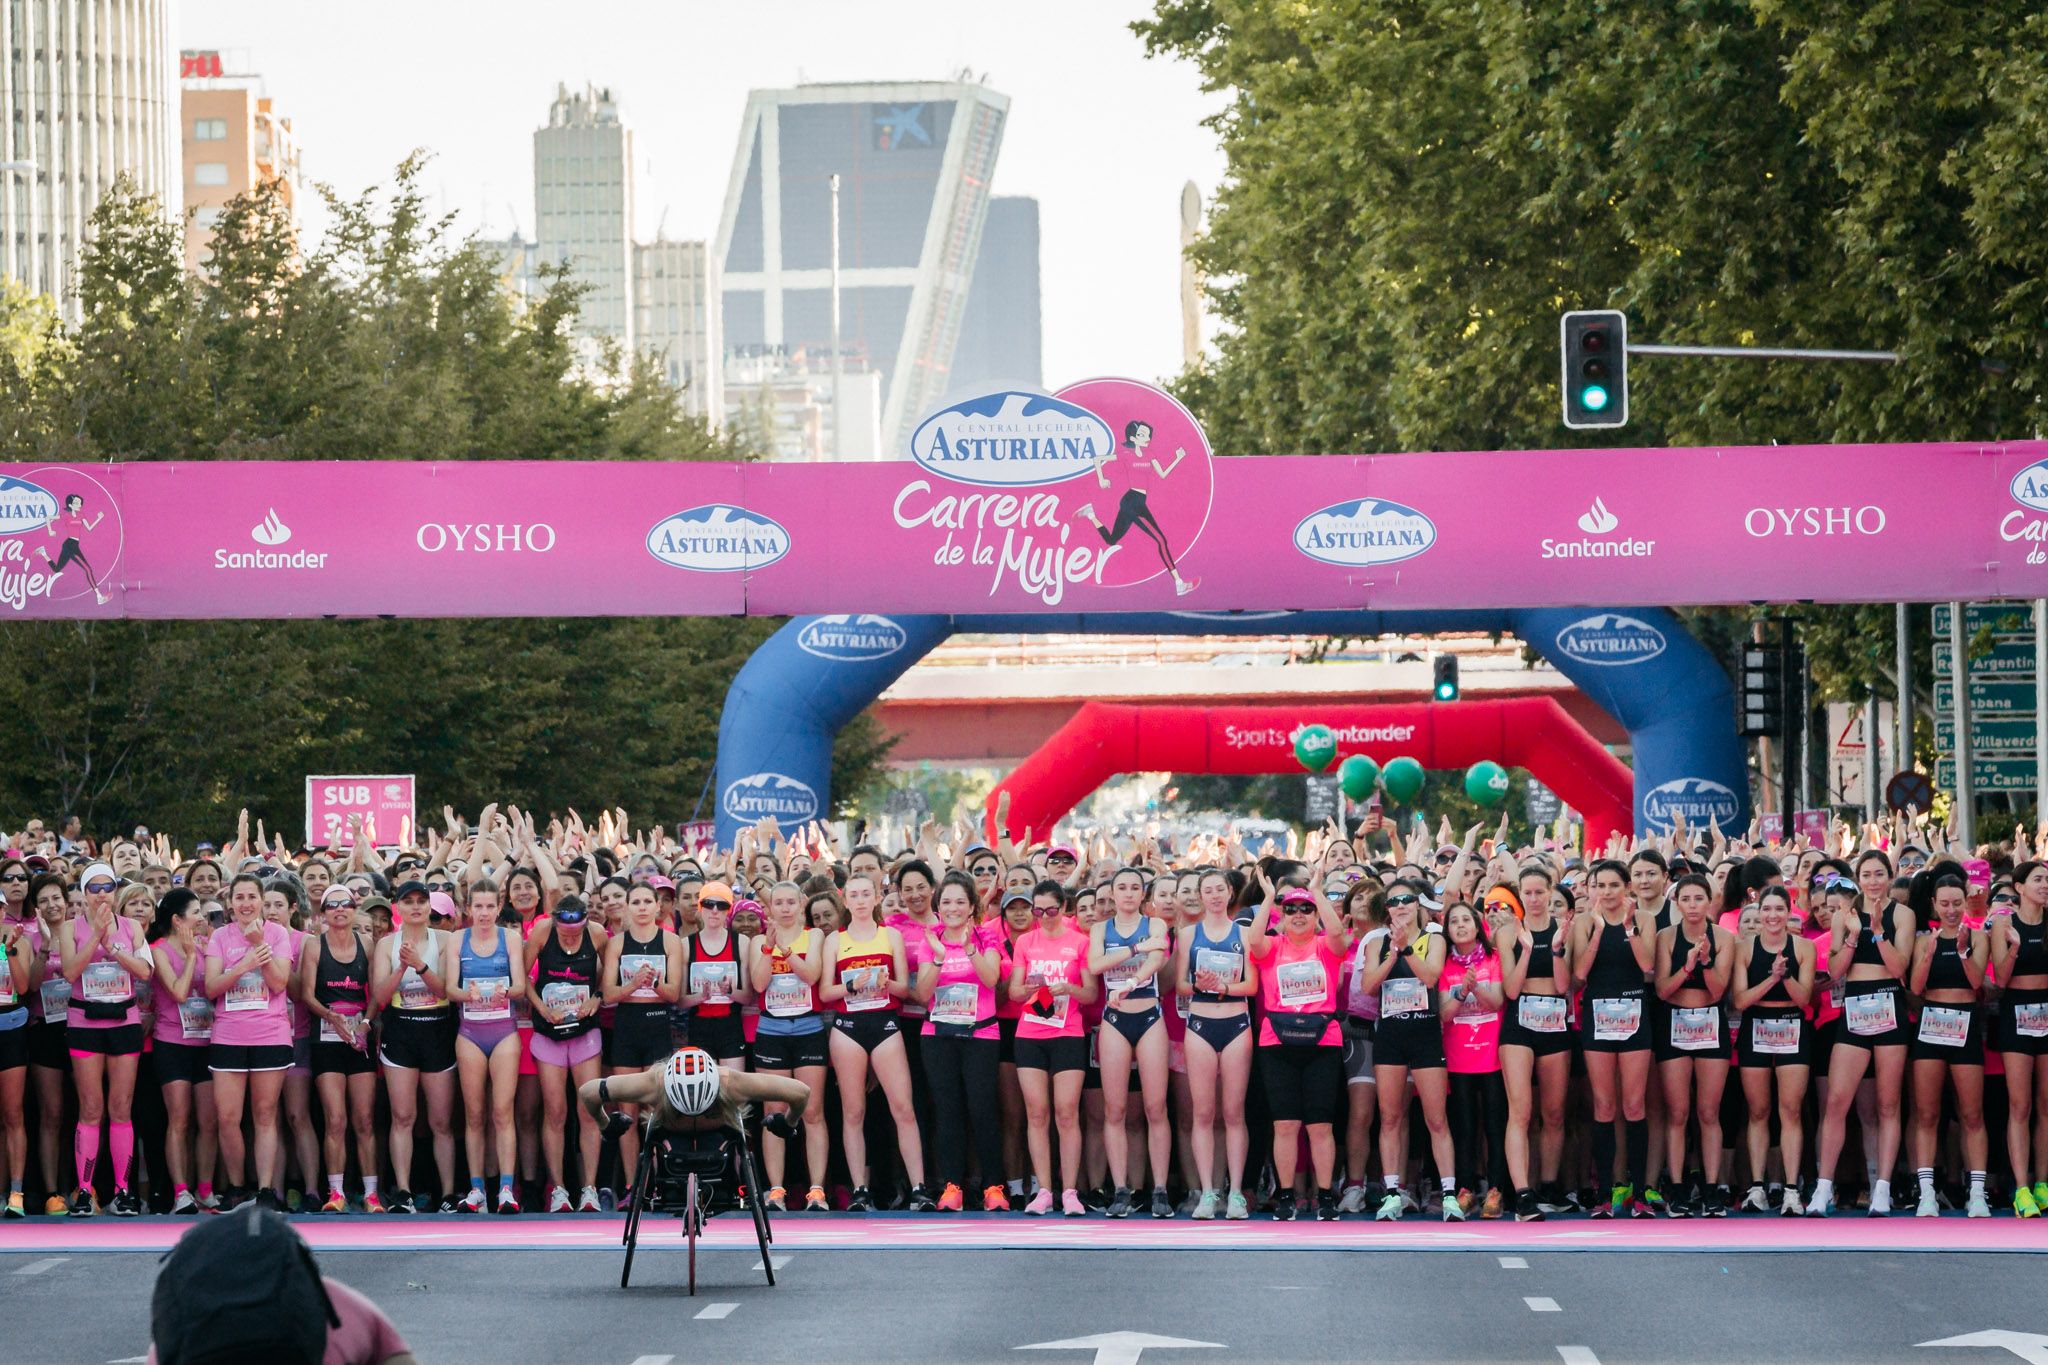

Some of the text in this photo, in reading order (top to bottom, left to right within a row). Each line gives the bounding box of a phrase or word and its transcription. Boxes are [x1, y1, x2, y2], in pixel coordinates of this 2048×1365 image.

[957, 423, 1092, 433] CENTRAL LECHERA
[926, 426, 1098, 461] ASTURIANA
[893, 480, 1060, 528] Carrera
[1744, 505, 1886, 537] OYSHO
[416, 523, 556, 552] OYSHO
[658, 529, 779, 554] ASTURIANA
[1306, 524, 1425, 549] ASTURIANA
[1541, 537, 1655, 558] Santander
[214, 548, 328, 568] Santander
[933, 523, 1123, 606] de la Mujer
[805, 627, 898, 649] ASTURIANA
[1566, 634, 1660, 653] ASTURIANA
[1973, 656, 2036, 671] Argentin
[1973, 686, 1986, 694] de
[1226, 725, 1286, 749] Sports
[1972, 736, 2037, 748] Villaverd
[324, 786, 371, 806] SUB
[730, 791, 812, 814] ASTURIANA
[1650, 797, 1733, 817] ASTURIANA
